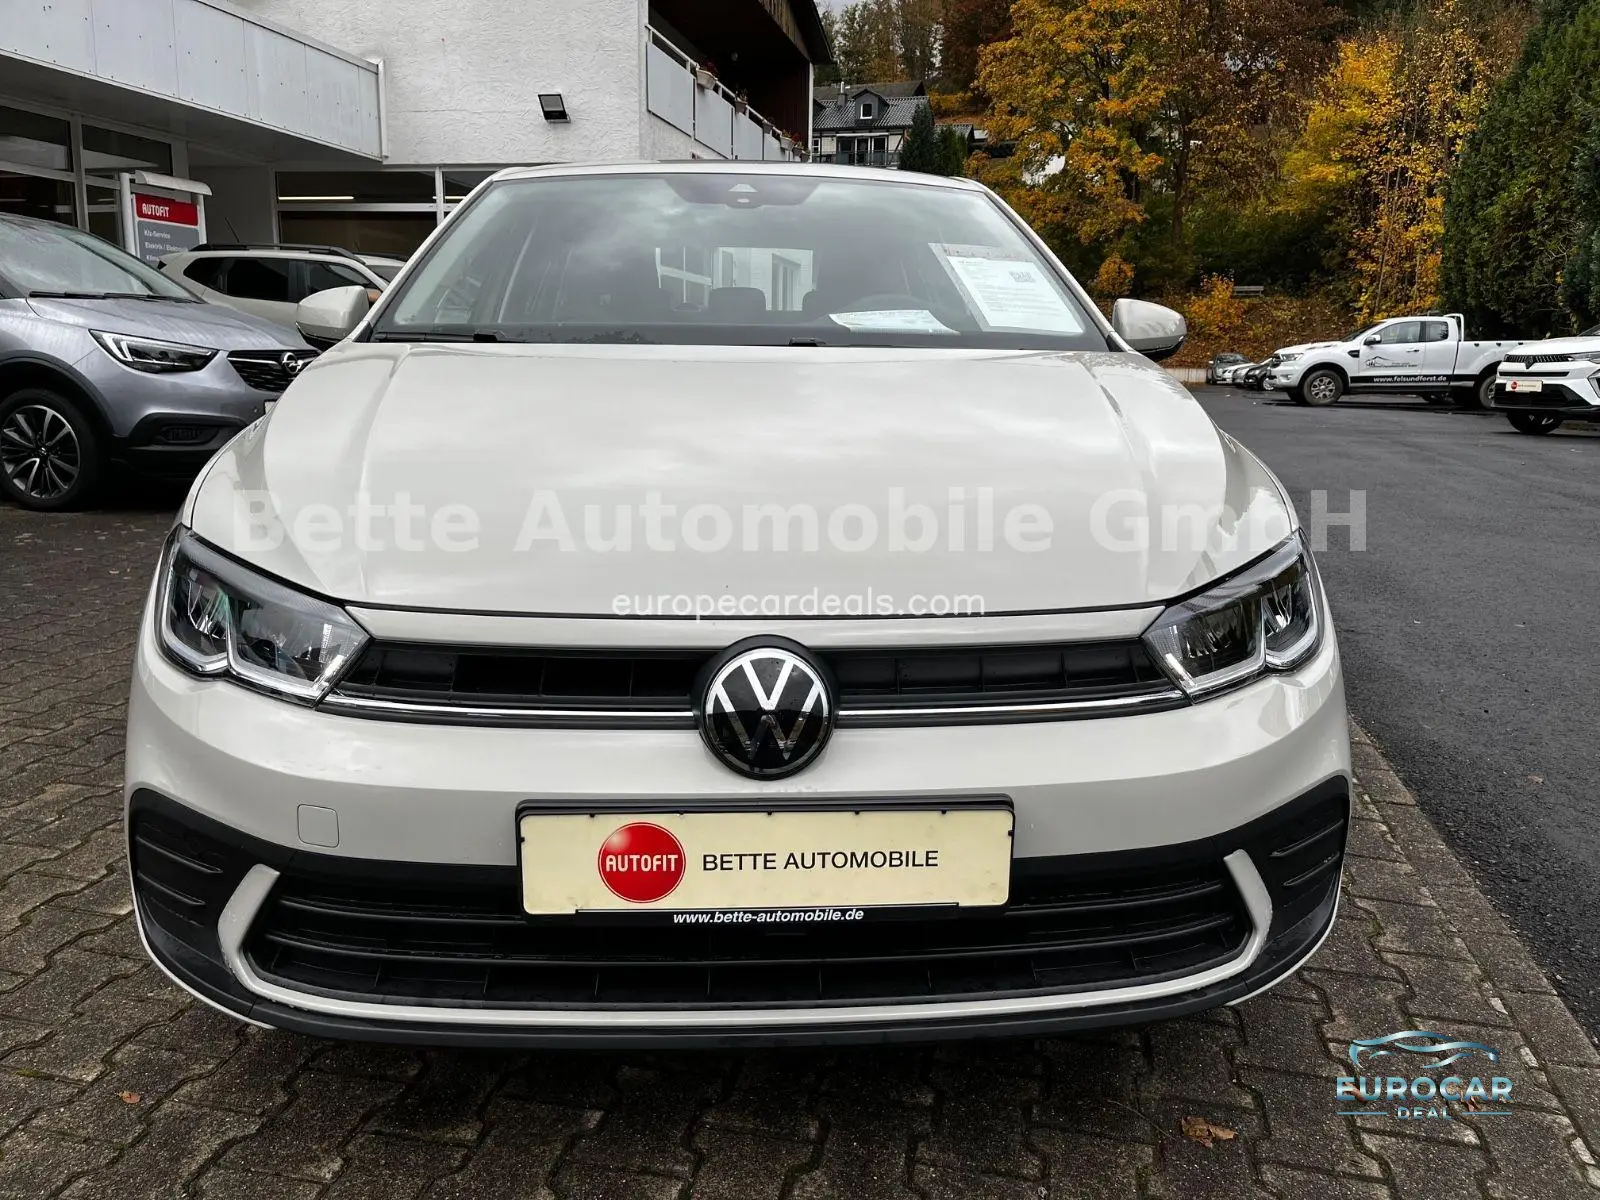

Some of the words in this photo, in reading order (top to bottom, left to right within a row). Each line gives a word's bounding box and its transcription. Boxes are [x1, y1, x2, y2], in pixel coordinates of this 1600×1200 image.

[142, 203, 169, 217] AUTOFIT
[605, 854, 679, 873] AUTOFIT
[702, 853, 777, 871] BETTE
[784, 850, 939, 870] AUTOMOBILE
[673, 908, 864, 924] www.bette-automobile.de
